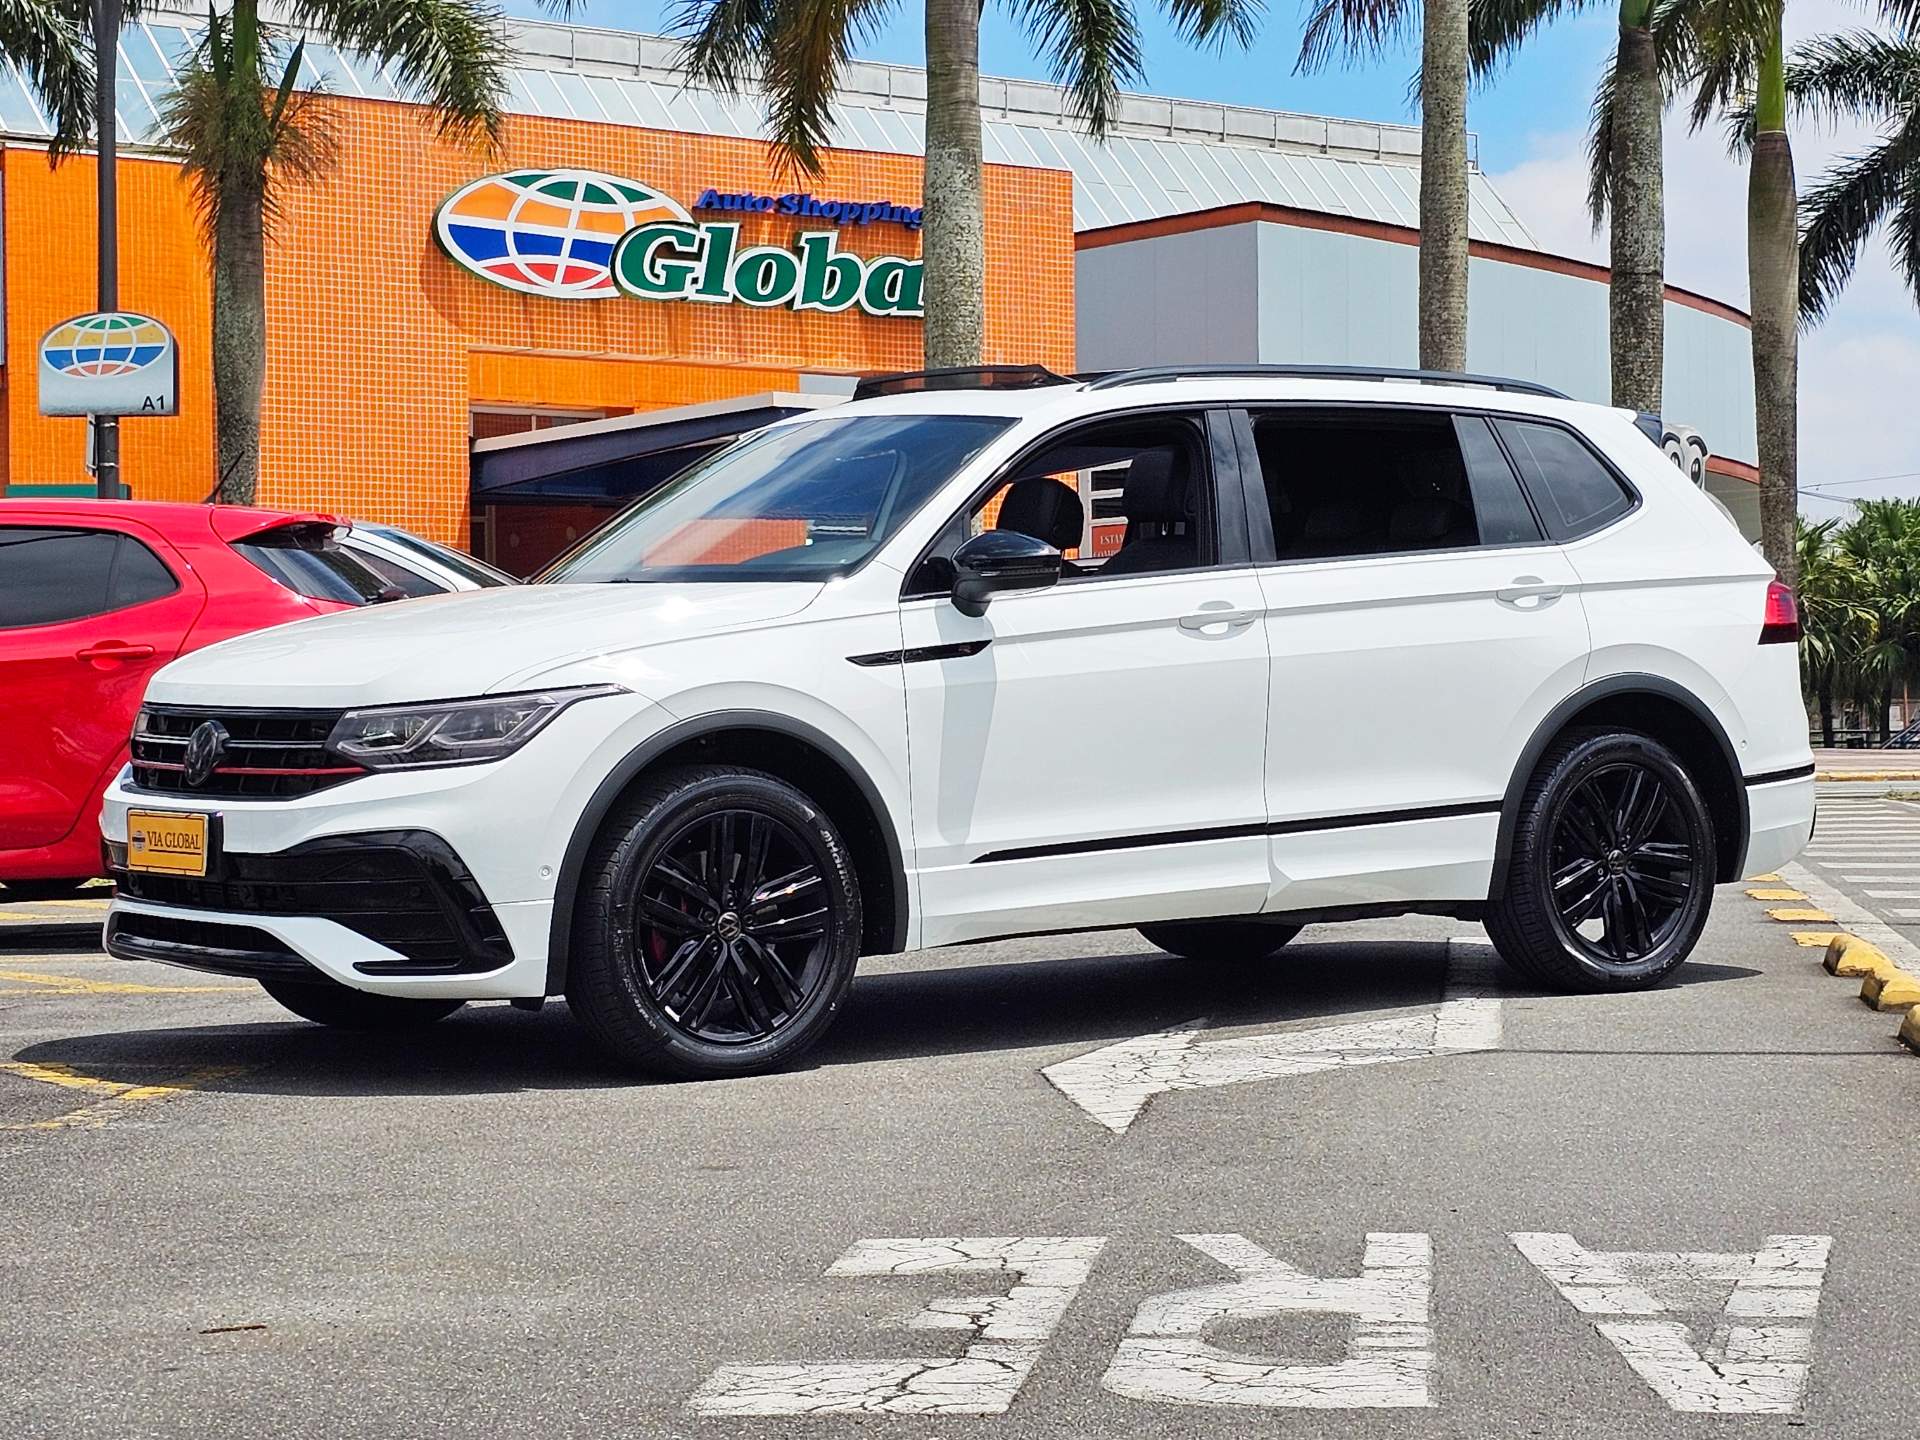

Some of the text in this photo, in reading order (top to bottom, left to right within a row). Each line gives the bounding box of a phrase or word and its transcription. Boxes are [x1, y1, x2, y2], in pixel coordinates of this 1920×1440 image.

[694, 188, 774, 213] Auto
[609, 220, 924, 317] Globa
[142, 395, 165, 410] A1
[147, 831, 201, 849] VIA GLOBAL
